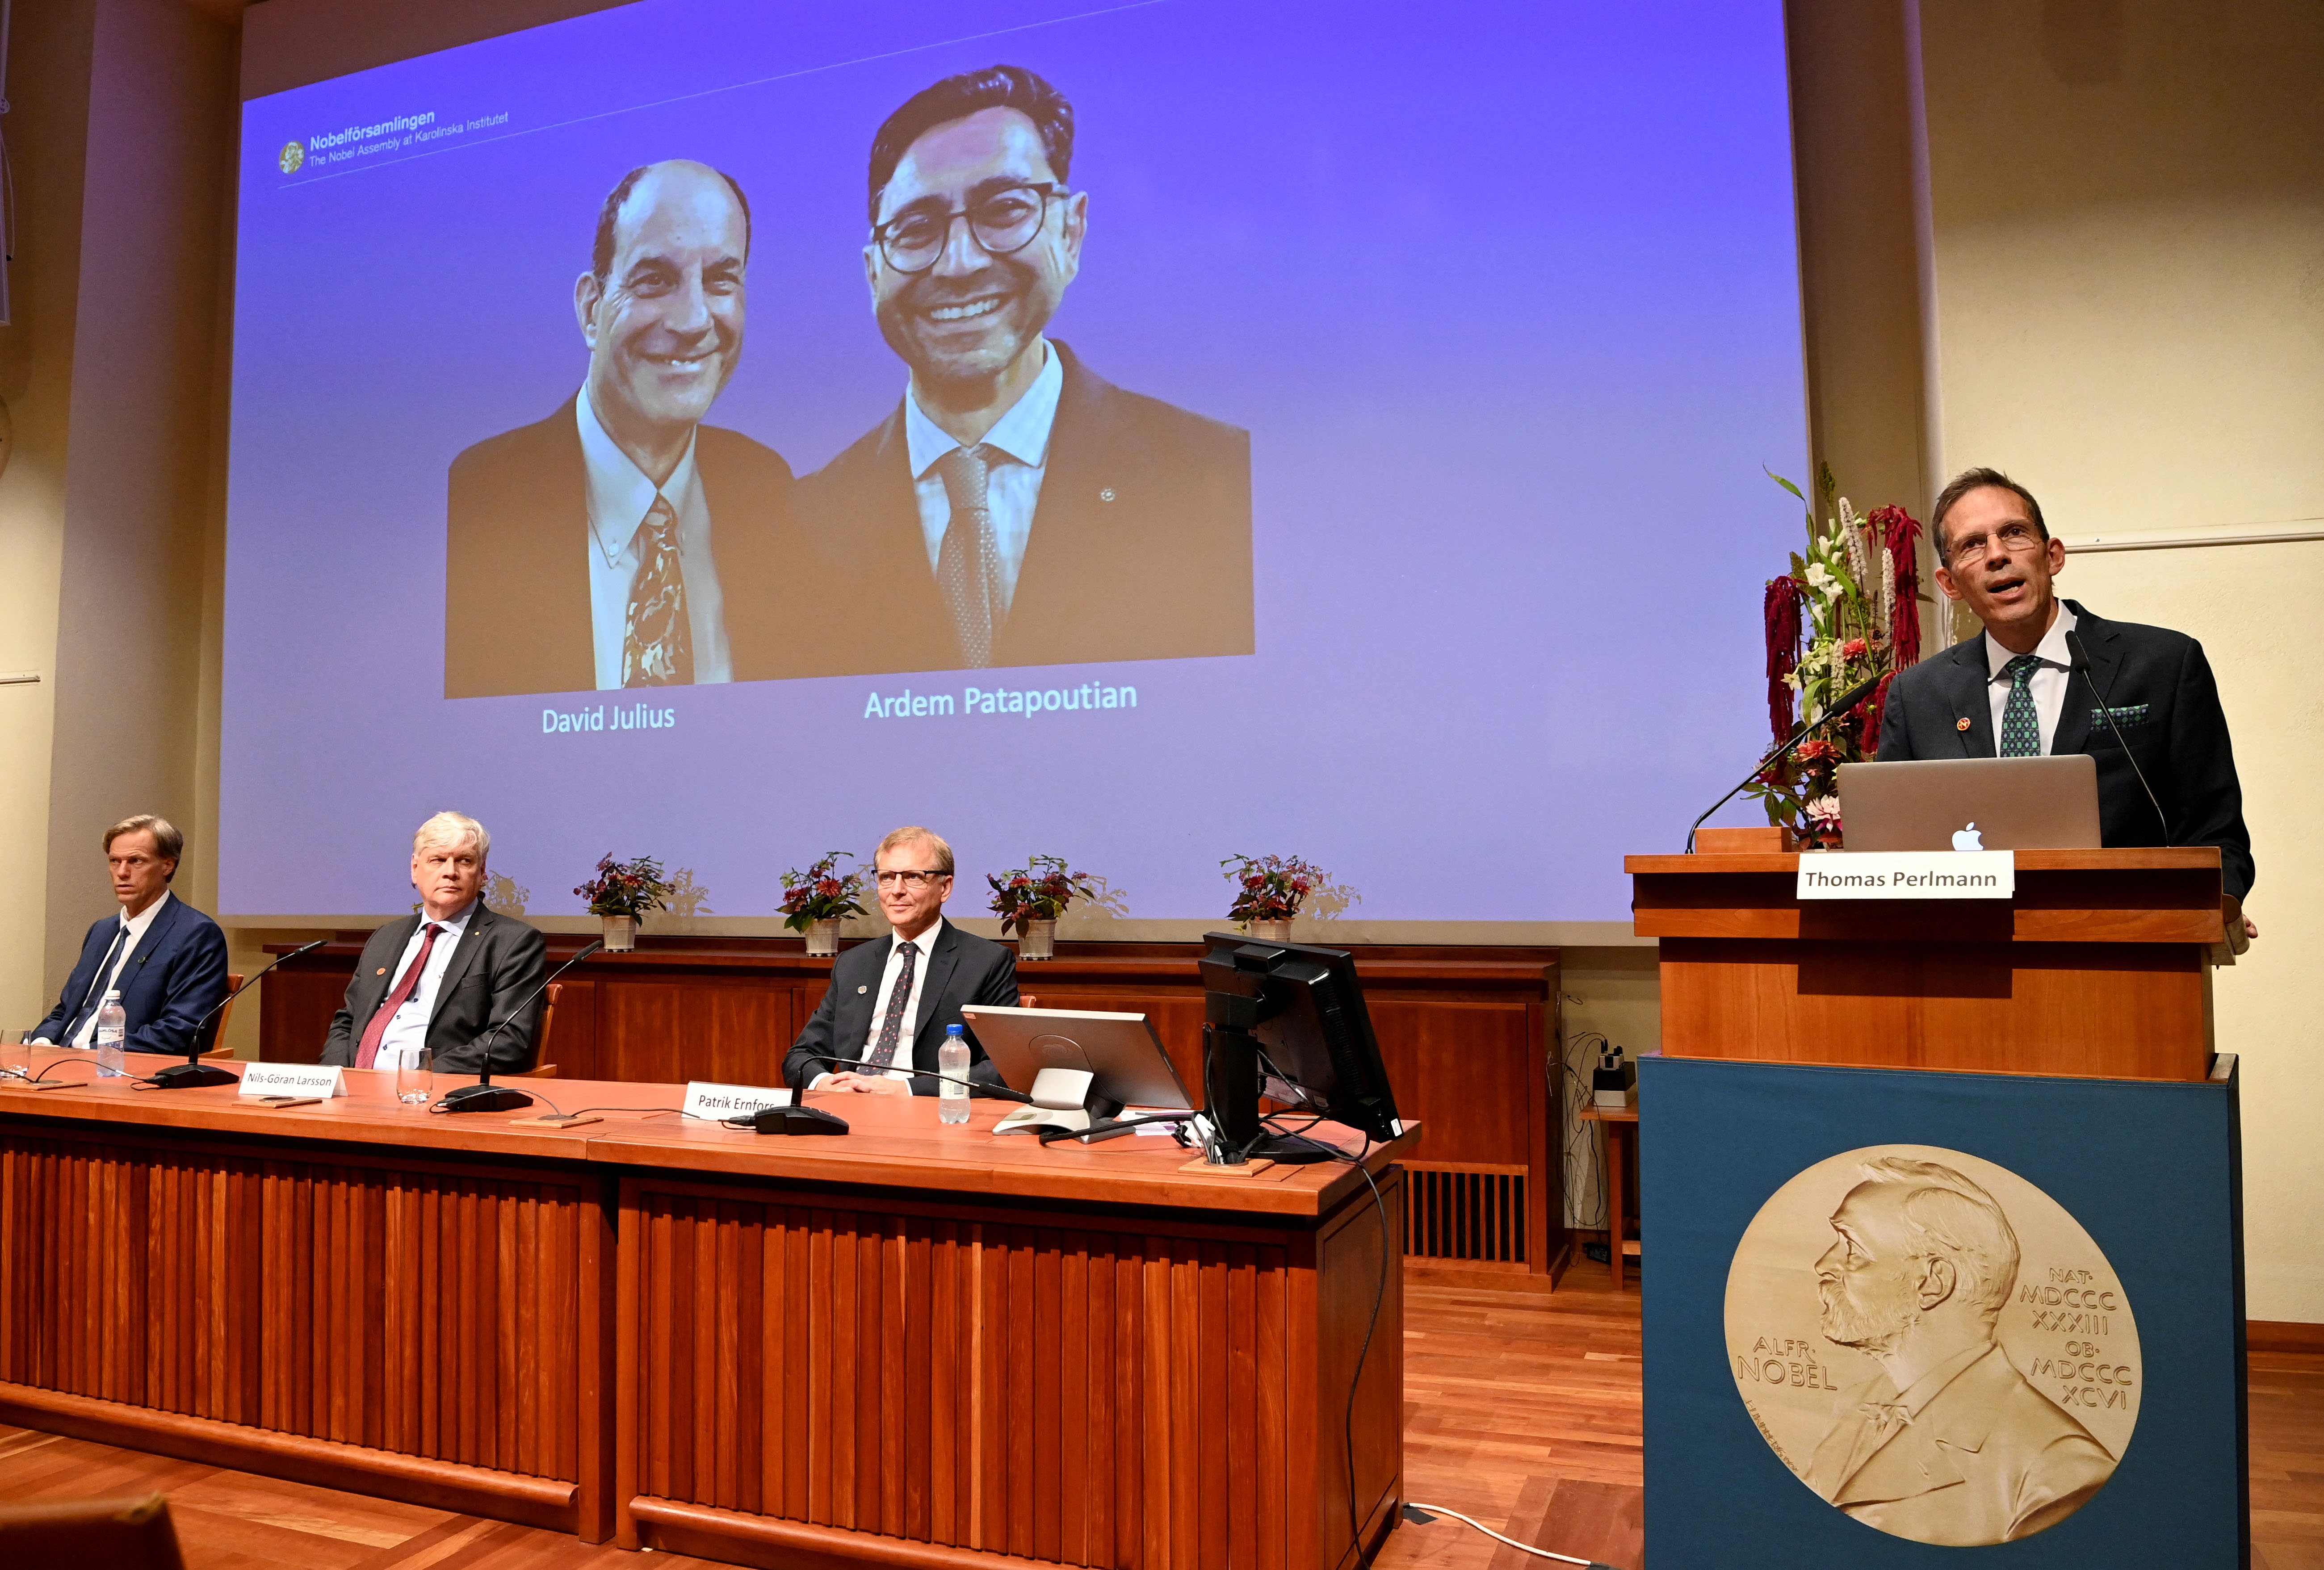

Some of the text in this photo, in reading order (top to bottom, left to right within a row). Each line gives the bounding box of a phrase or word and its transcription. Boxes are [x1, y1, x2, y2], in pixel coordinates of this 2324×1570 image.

[310, 111, 435, 151] Nobelförsamlingen
[310, 111, 508, 167] The Nobel Assembly at Karolinska Institutet
[864, 681, 1137, 719] Ardem Patapoutian
[543, 703, 675, 733] David Julius
[1805, 871, 1997, 887] Thomas Perlmann
[247, 1073, 331, 1086] Nils-Göran Larsson
[699, 1095, 731, 1109] Patrik
[2020, 1285, 2117, 1311] MDCCC
[2032, 1310, 2108, 1335] XXXIII
[1737, 1356, 1837, 1391] NOBEL
[2031, 1358, 2132, 1385] MDCCC
[2062, 1385, 2126, 1410] XCVI
